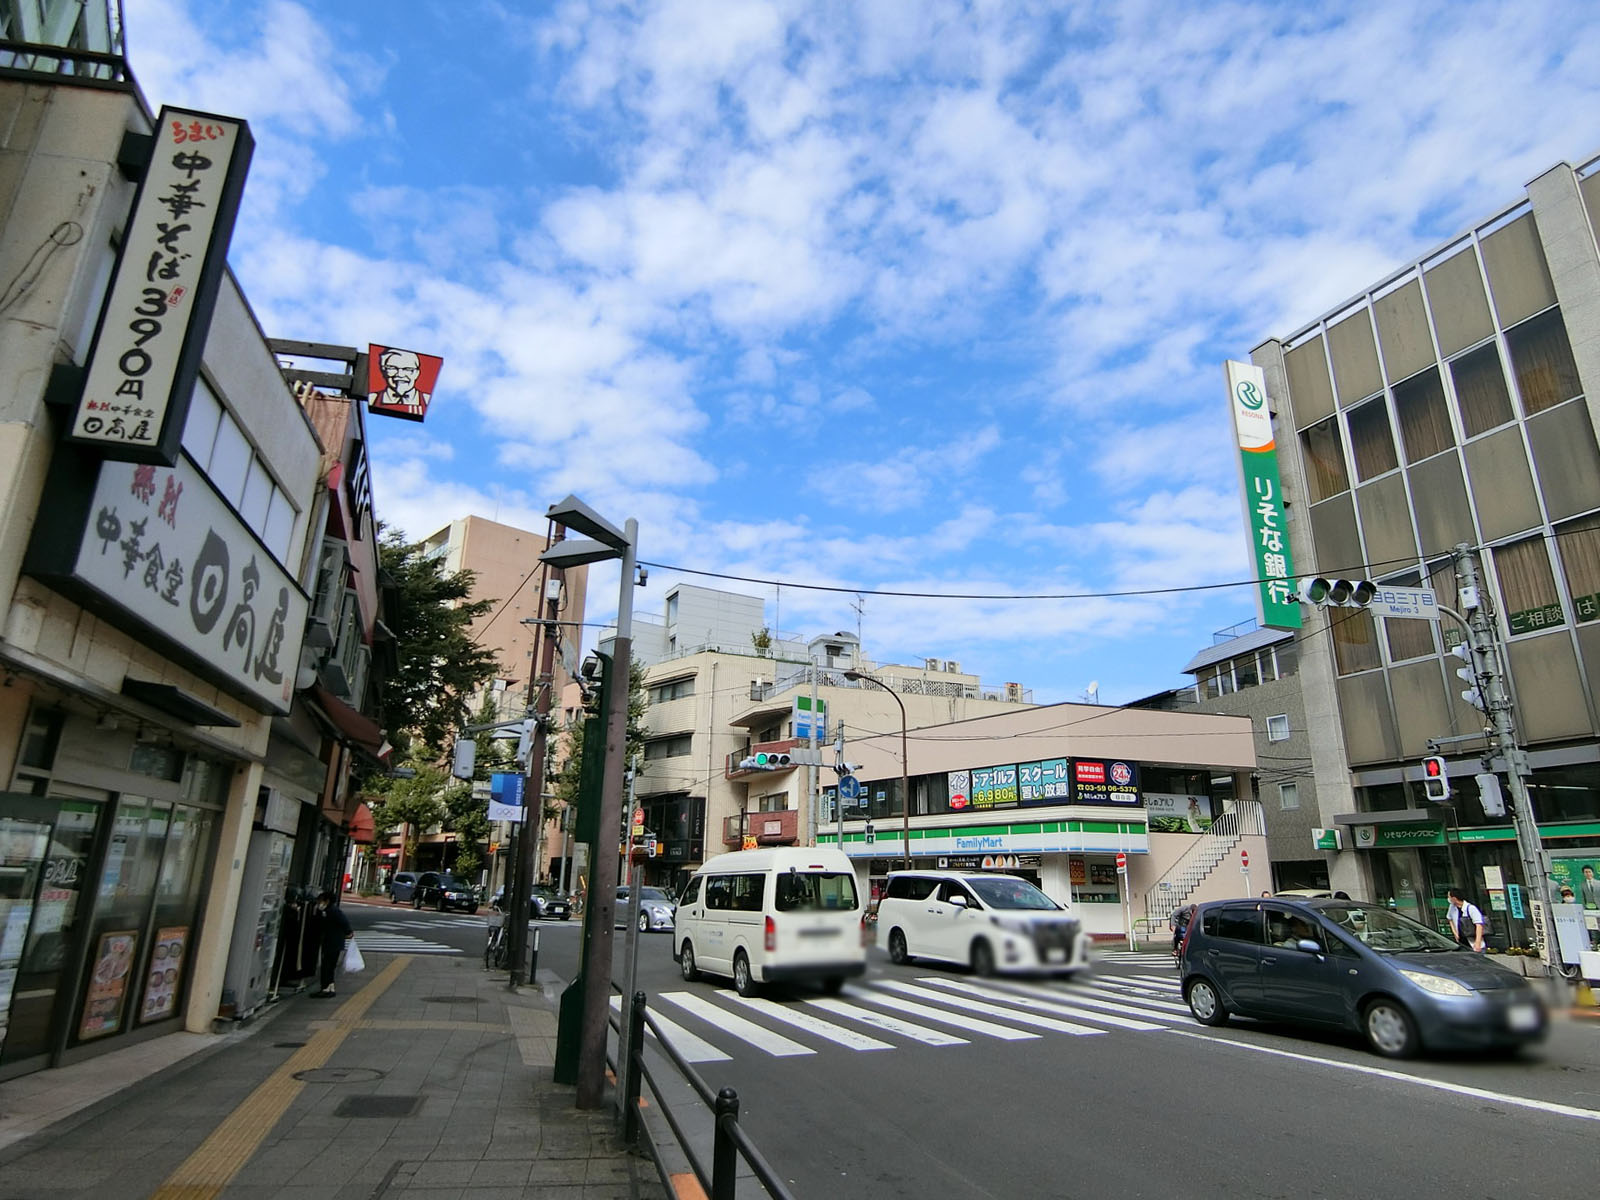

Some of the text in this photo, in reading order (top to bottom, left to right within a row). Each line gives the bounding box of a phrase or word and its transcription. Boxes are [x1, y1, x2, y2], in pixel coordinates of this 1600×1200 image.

[171, 121, 225, 144] うまい
[83, 416, 152, 440] 日高屋
[1254, 476, 1291, 605] りそな銀行
[96, 506, 184, 607] 中華食堂
[189, 524, 290, 686] 日高屋
[1372, 592, 1434, 606] 目白三丁目
[1389, 605, 1419, 614] Mejiro 3
[956, 837, 1003, 852] FamilyMart
